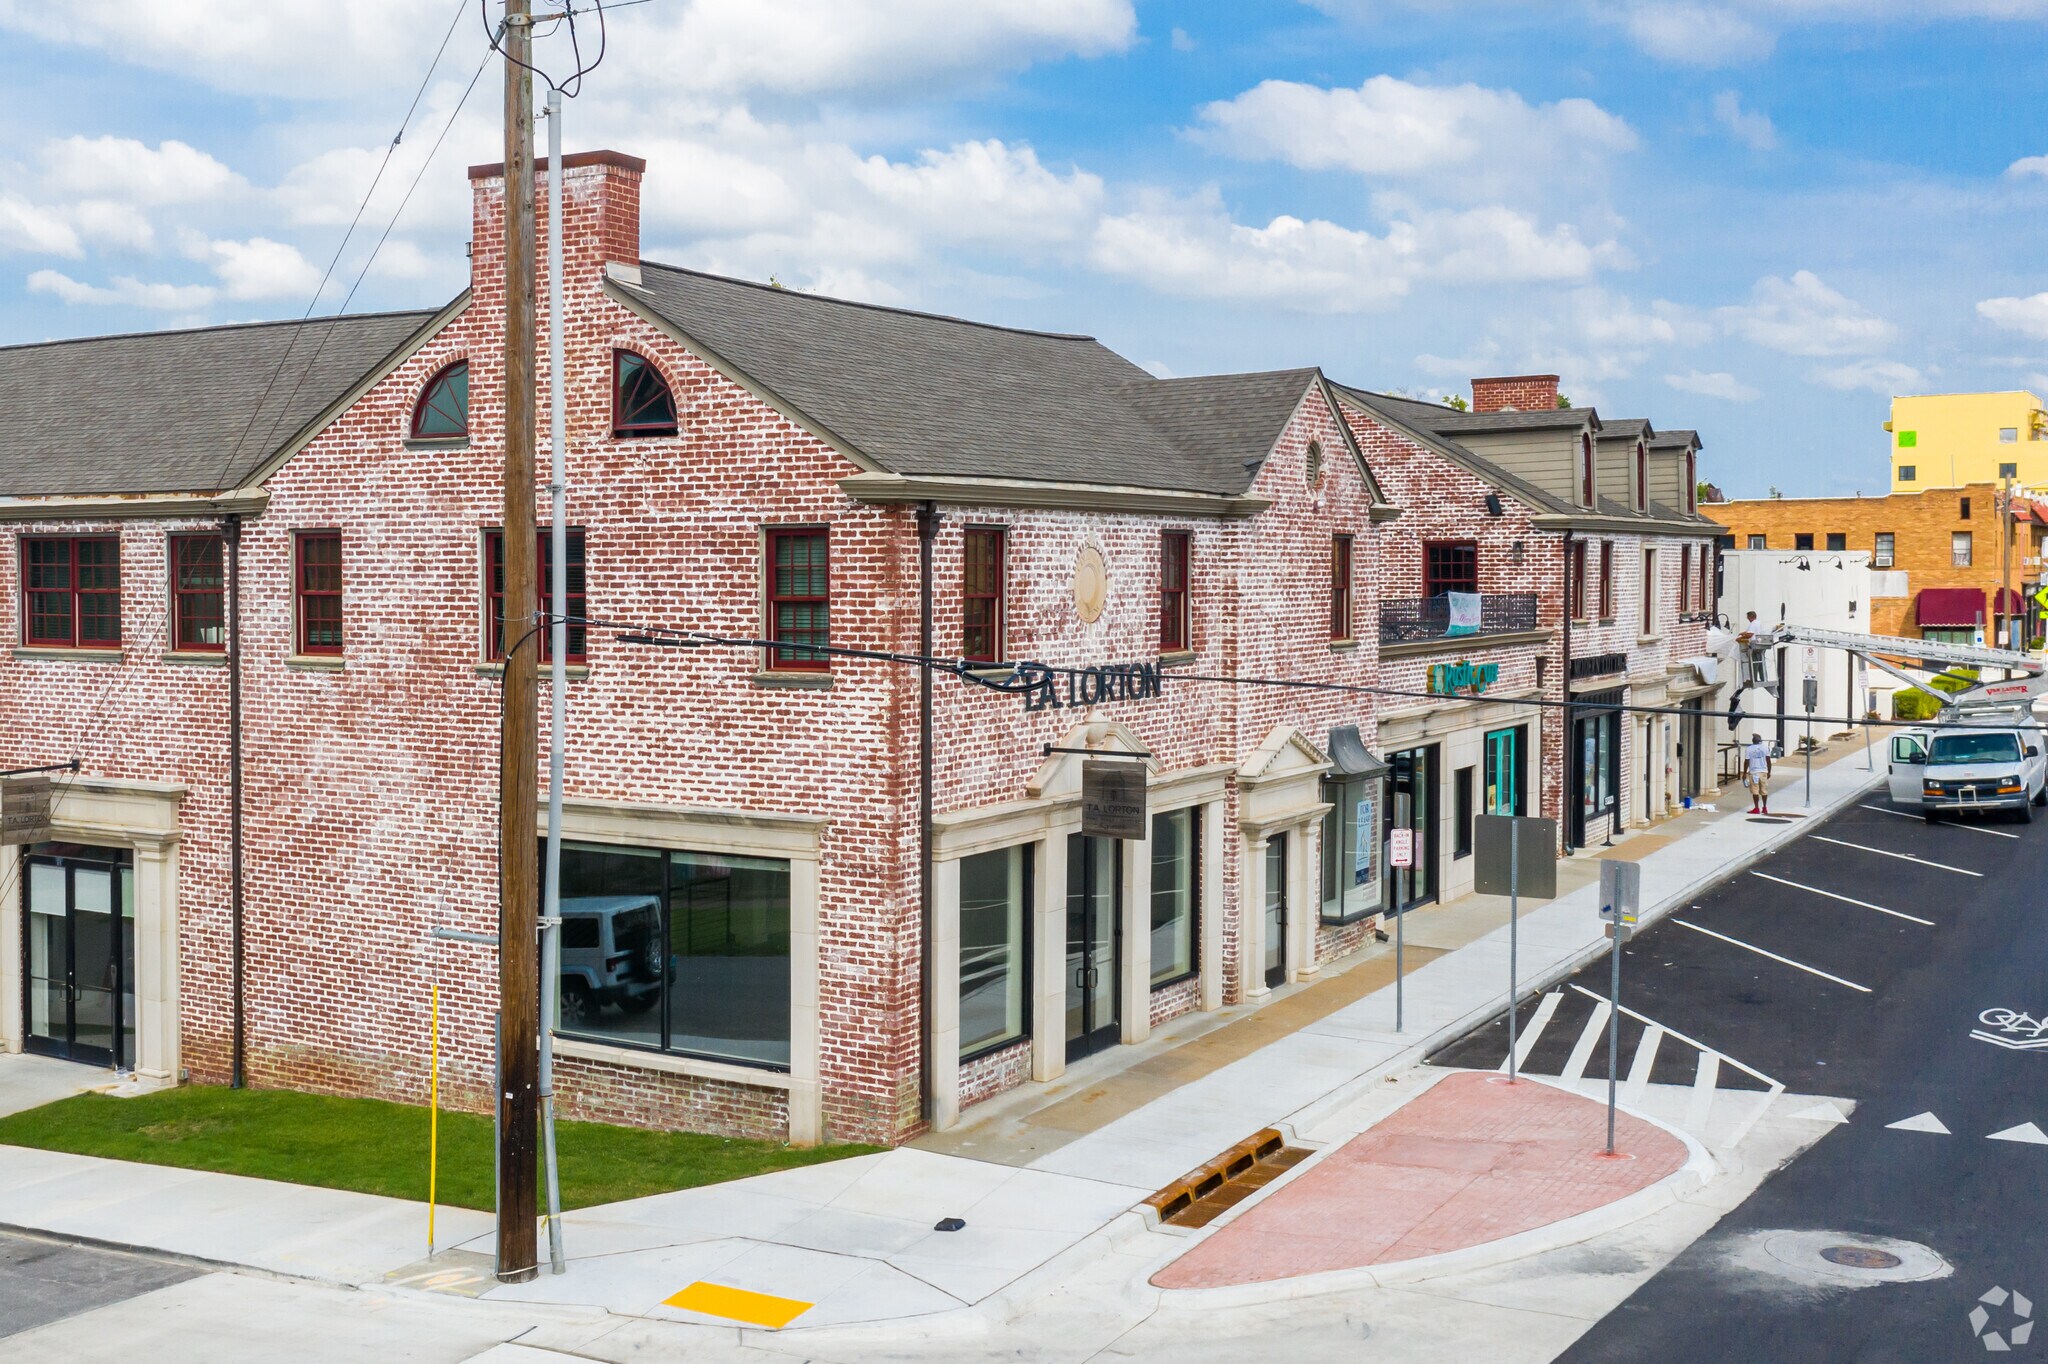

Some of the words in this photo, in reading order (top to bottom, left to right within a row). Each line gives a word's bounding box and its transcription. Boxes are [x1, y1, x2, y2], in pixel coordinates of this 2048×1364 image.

[1069, 662, 1161, 707] LORTON
[1103, 805, 1140, 814] LORTON
[20, 815, 48, 823] LORTON
